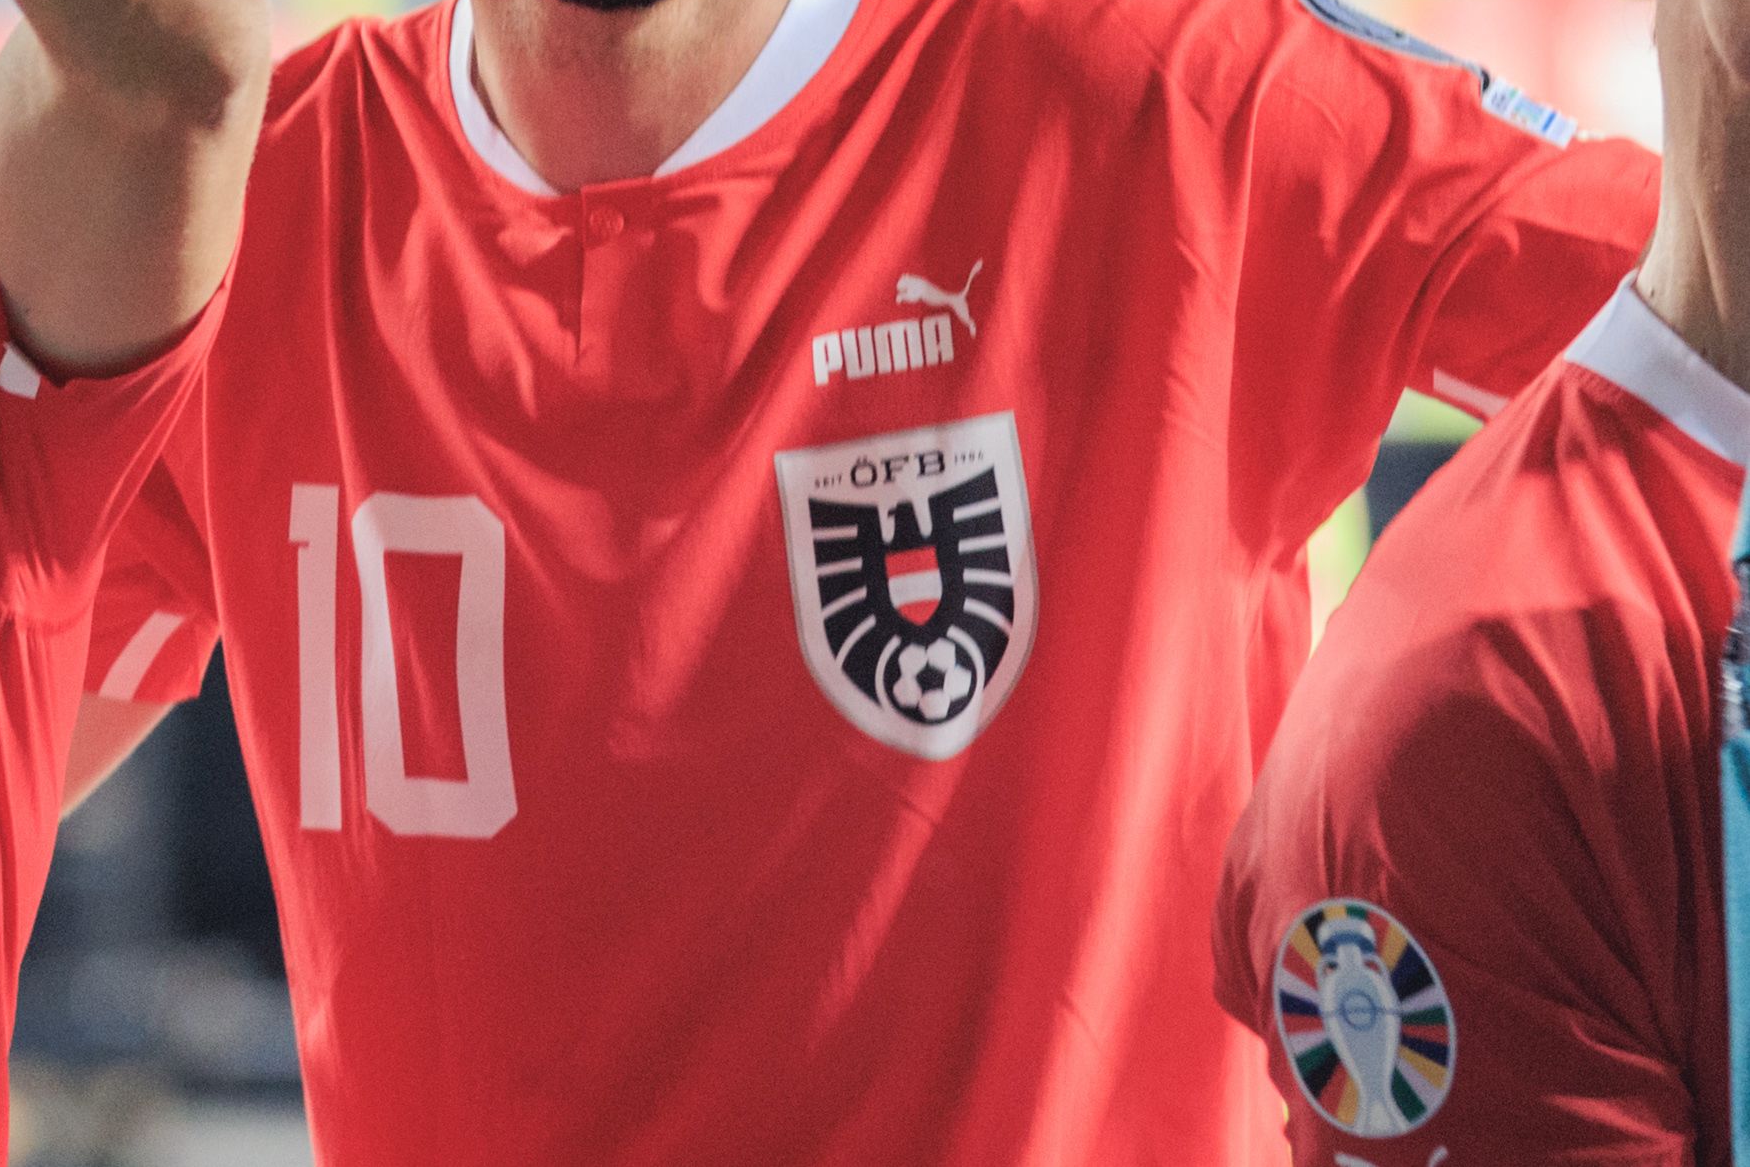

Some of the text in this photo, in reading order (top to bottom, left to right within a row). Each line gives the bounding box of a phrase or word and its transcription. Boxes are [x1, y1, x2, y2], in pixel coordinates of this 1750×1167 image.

[812, 312, 954, 387] PUMA
[850, 449, 946, 488] ÖFB
[289, 484, 518, 838] 10
